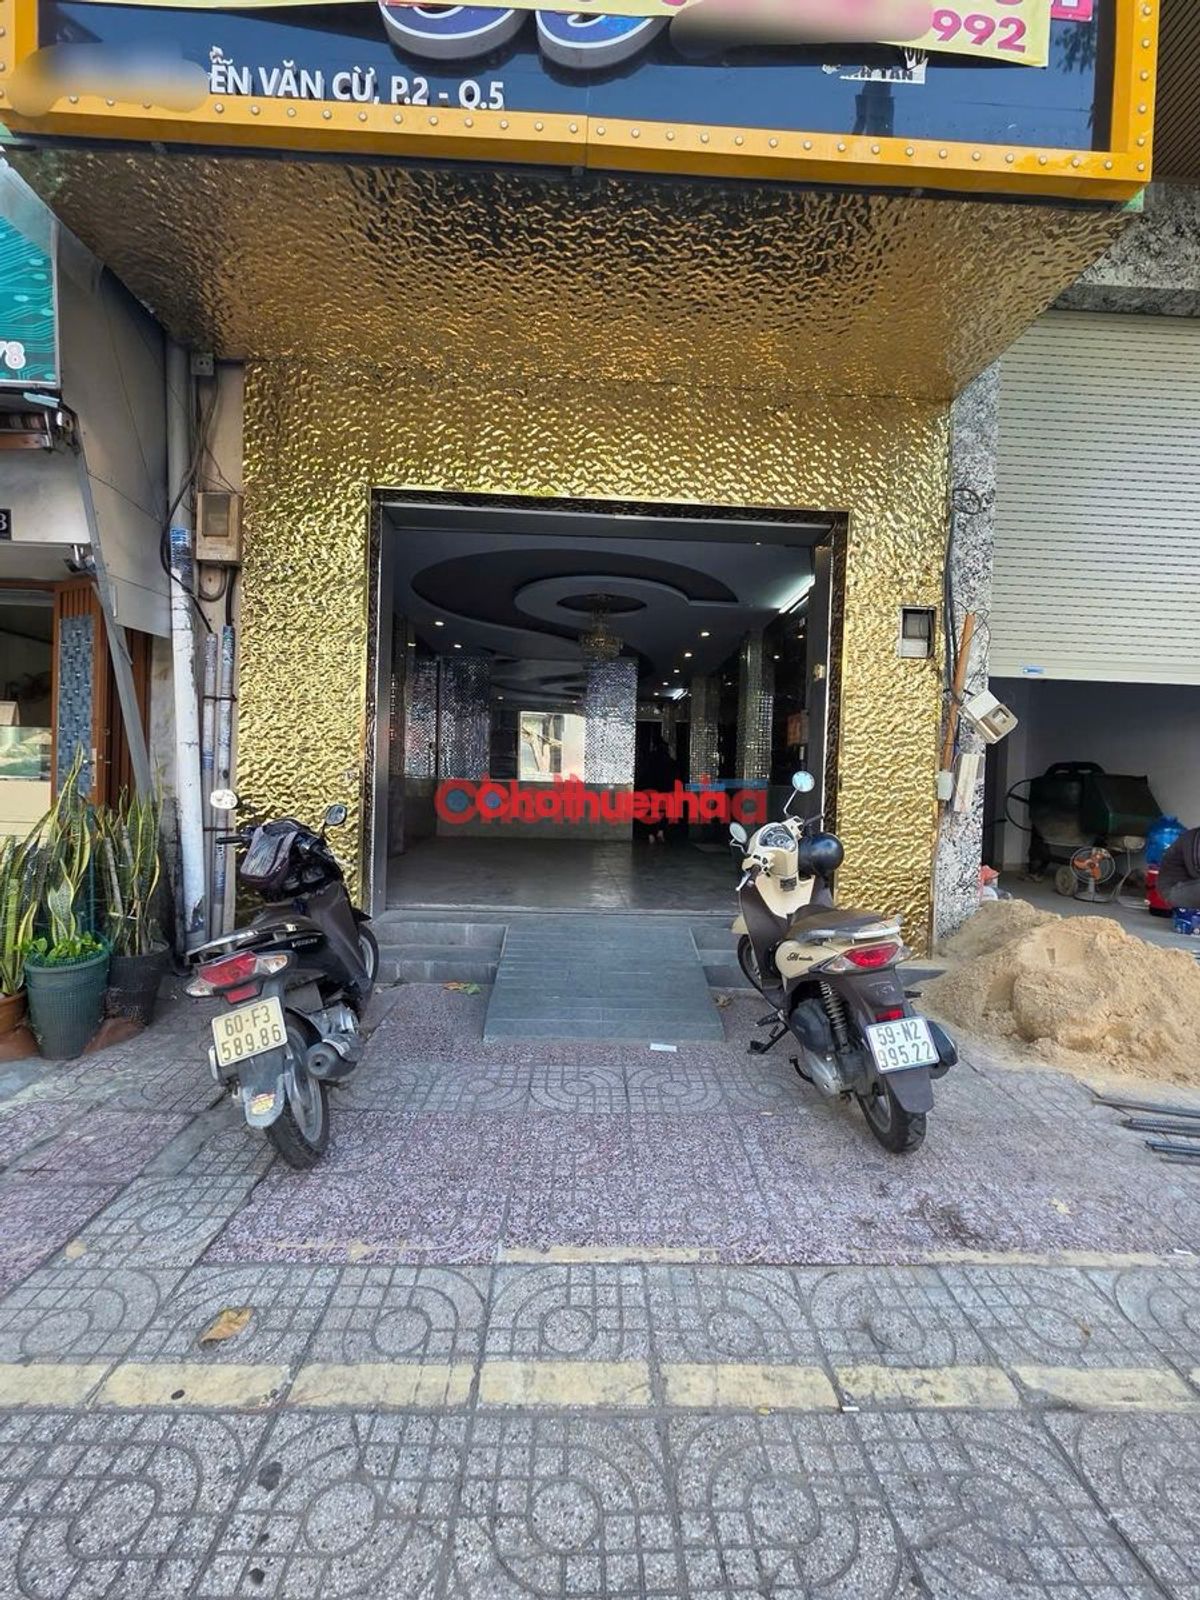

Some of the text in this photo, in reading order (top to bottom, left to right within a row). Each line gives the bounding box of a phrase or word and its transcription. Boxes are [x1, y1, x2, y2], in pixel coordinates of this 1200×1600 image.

[931, 9, 1026, 53] 992
[208, 46, 250, 95] ỄN
[258, 60, 322, 99] VĂN
[391, 75, 428, 105] P.2
[438, 91, 449, 99] -
[458, 80, 504, 111] Q.5
[224, 1005, 270, 1036] 60-F3
[876, 1021, 921, 1046] 59-N2
[221, 1023, 282, 1060] 589.86
[877, 1041, 932, 1068] 995.22
